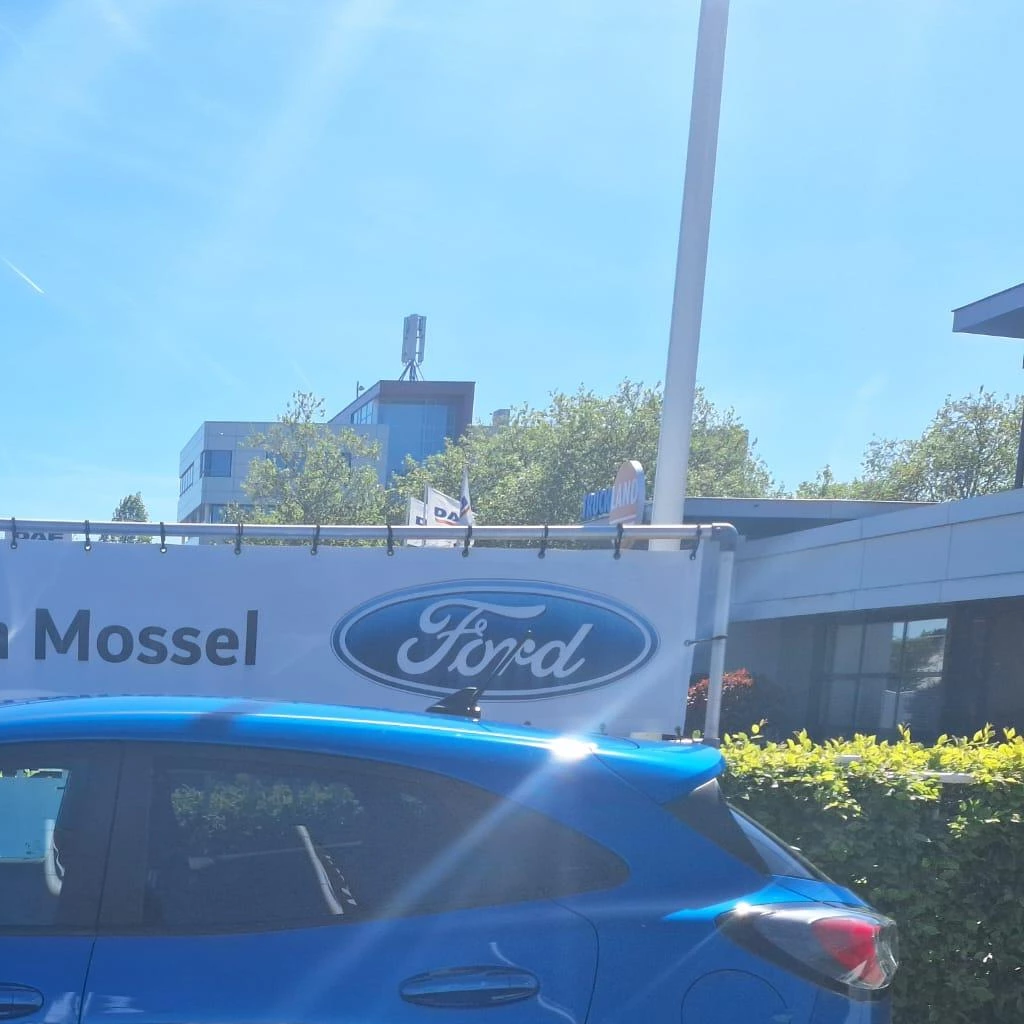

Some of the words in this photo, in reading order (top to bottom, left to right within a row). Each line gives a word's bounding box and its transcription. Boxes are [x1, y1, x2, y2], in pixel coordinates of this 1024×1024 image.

[435, 506, 460, 521] DA
[34, 608, 259, 666] Mossel
[397, 599, 594, 678] Ford
